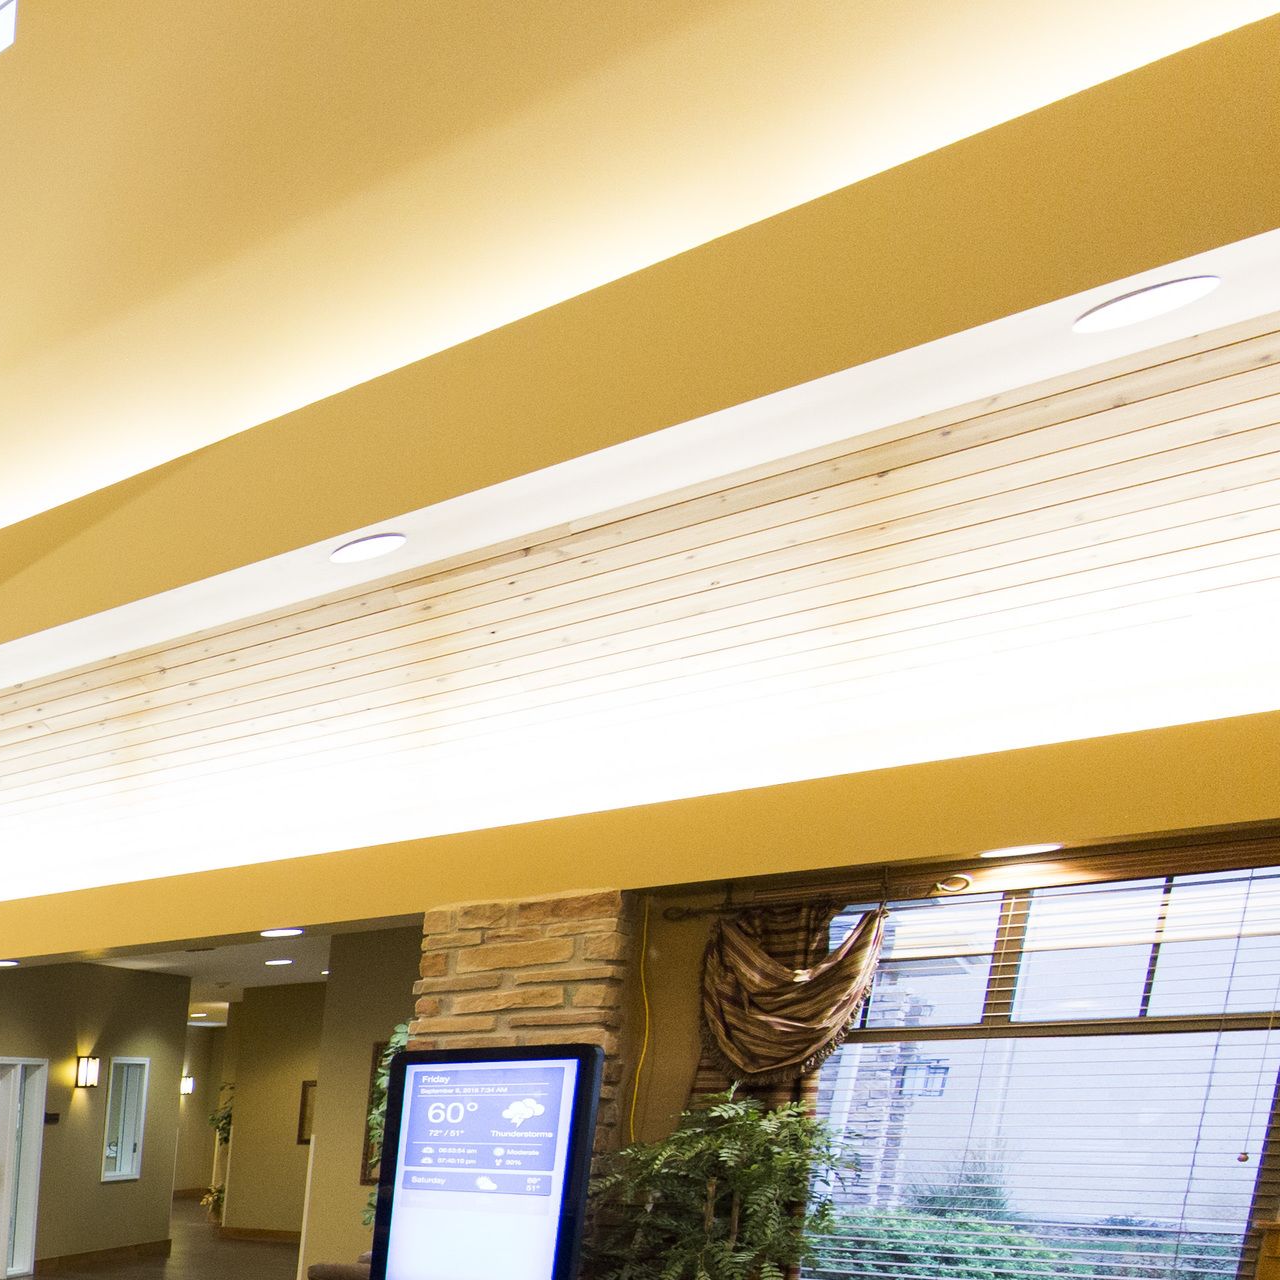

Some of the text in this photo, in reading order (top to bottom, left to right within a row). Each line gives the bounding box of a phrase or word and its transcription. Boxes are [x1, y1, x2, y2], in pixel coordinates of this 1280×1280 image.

[422, 1075, 450, 1084] Friday
[427, 1102, 478, 1123] 60°
[490, 1129, 553, 1138] Thunderstorms
[411, 1175, 446, 1185] Saturday
